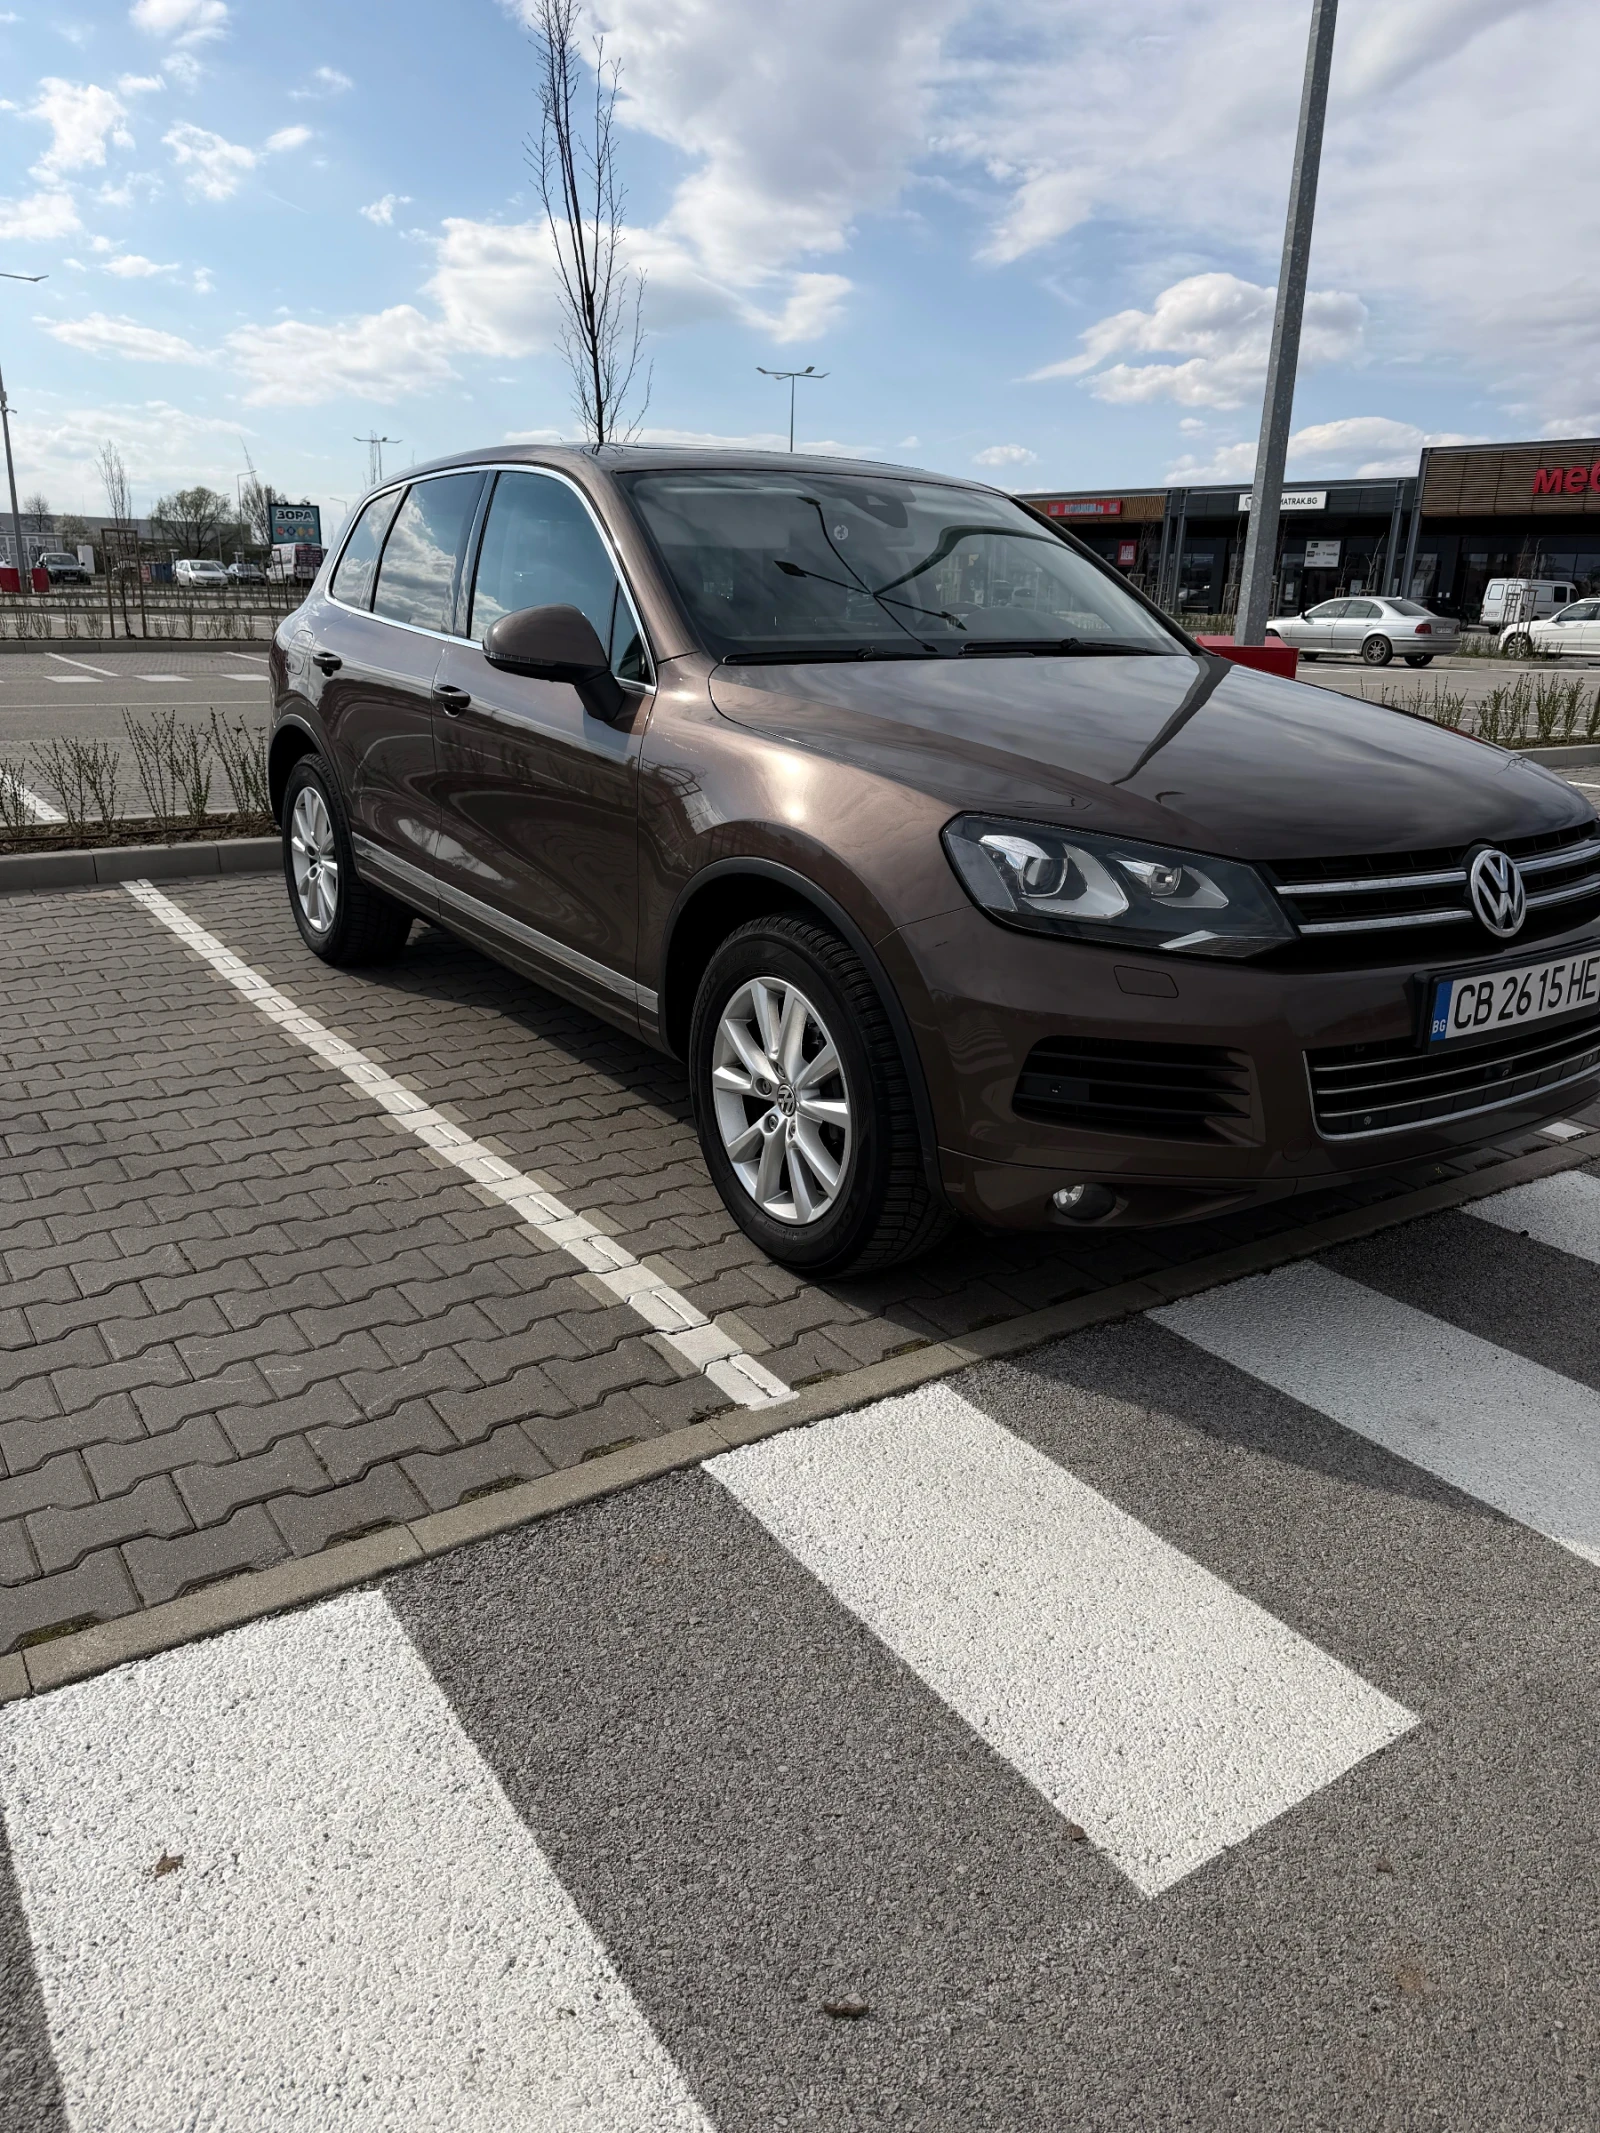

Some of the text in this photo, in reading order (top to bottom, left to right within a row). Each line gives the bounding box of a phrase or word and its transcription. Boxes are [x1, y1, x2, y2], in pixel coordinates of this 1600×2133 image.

[276, 510, 314, 521] ЗОРА
[1453, 957, 1600, 1029] CB 2615 HE
[1432, 1019, 1446, 1034] BG
